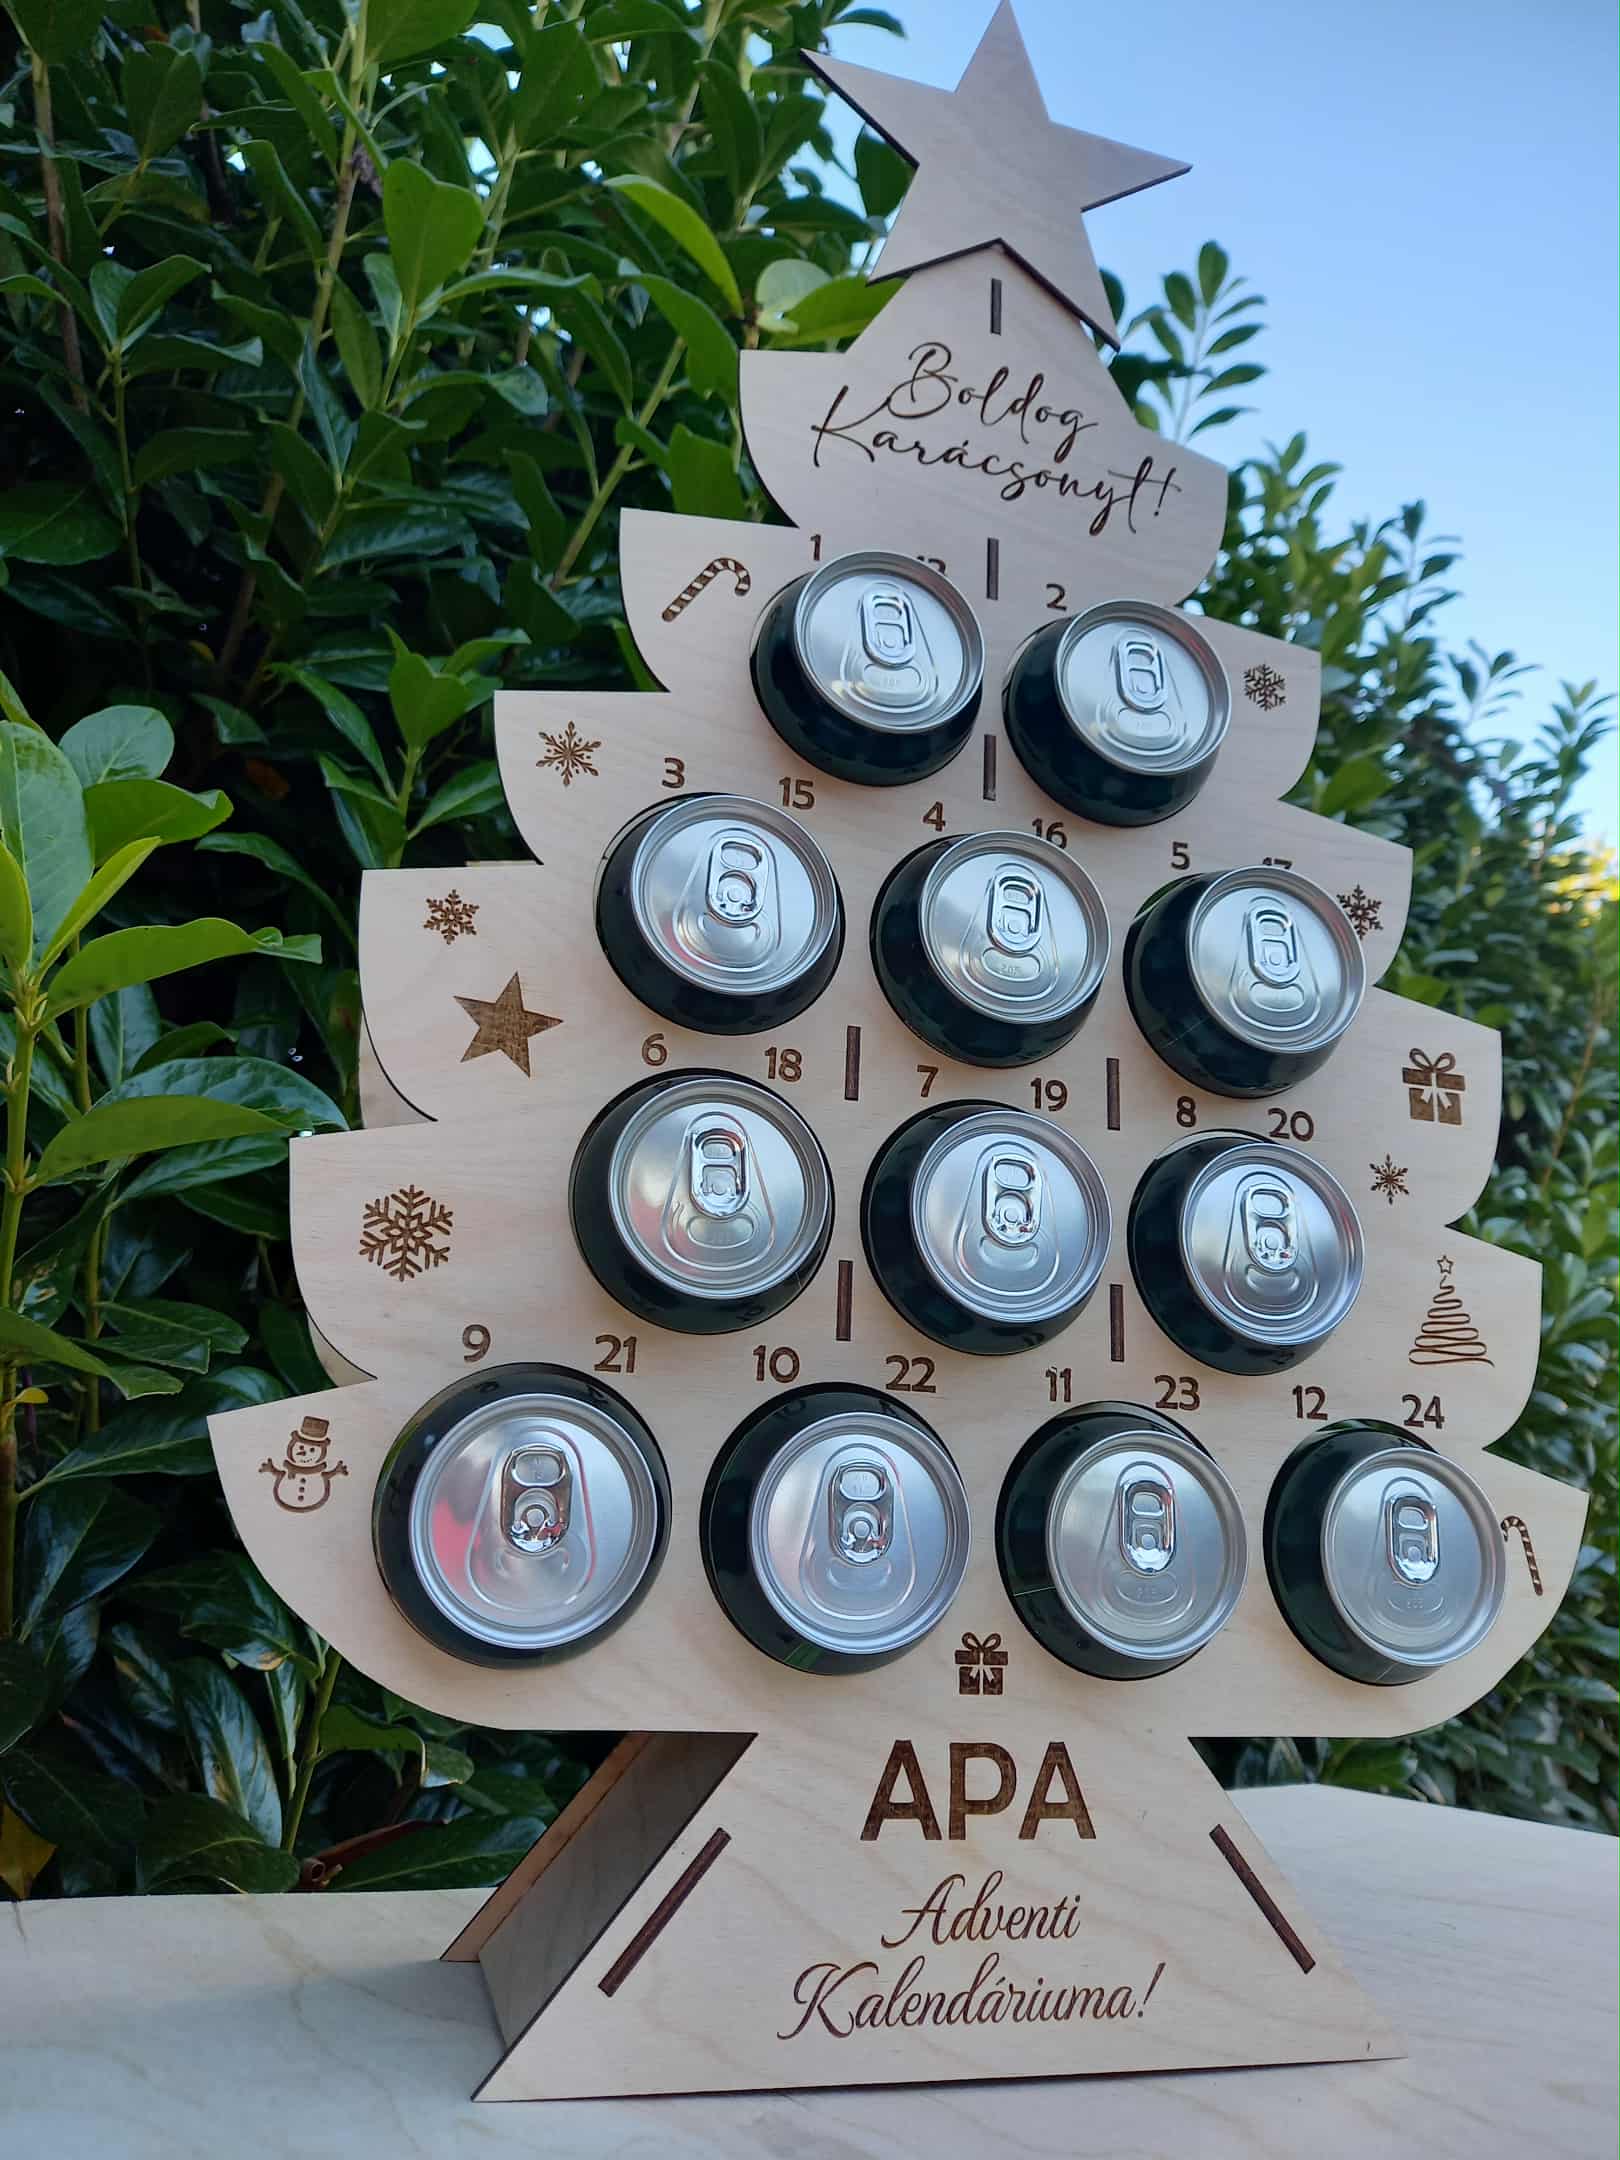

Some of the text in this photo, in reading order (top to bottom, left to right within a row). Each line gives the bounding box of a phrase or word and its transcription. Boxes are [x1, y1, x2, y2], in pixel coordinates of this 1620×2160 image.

[886, 341, 1099, 463] Boldog
[811, 384, 1182, 536] Karácsonyt!
[810, 534, 822, 561] 1
[1046, 583, 1068, 611] 2
[661, 757, 686, 789] 3
[778, 776, 815, 810] 15
[922, 801, 946, 832] 4
[1031, 818, 1068, 850] 16
[1170, 841, 1191, 871] 5
[641, 1033, 668, 1066] 6
[764, 1046, 803, 1082] 18
[916, 1064, 939, 1098] 7
[1030, 1077, 1068, 1112] 19
[1176, 1096, 1197, 1128] 8
[1267, 1108, 1314, 1142] 20
[461, 1324, 492, 1363] 9
[594, 1334, 638, 1374] 21
[753, 1344, 801, 1384] 10
[885, 1355, 937, 1393] 22
[1045, 1366, 1072, 1402] 11
[1154, 1375, 1200, 1411] 23
[1292, 1385, 1328, 1421] 12
[1401, 1394, 1445, 1429] 24
[859, 1739, 1097, 1841] APA
[880, 1870, 1081, 1949] Adventi
[776, 1952, 1166, 2040] Kalendáriuma!
